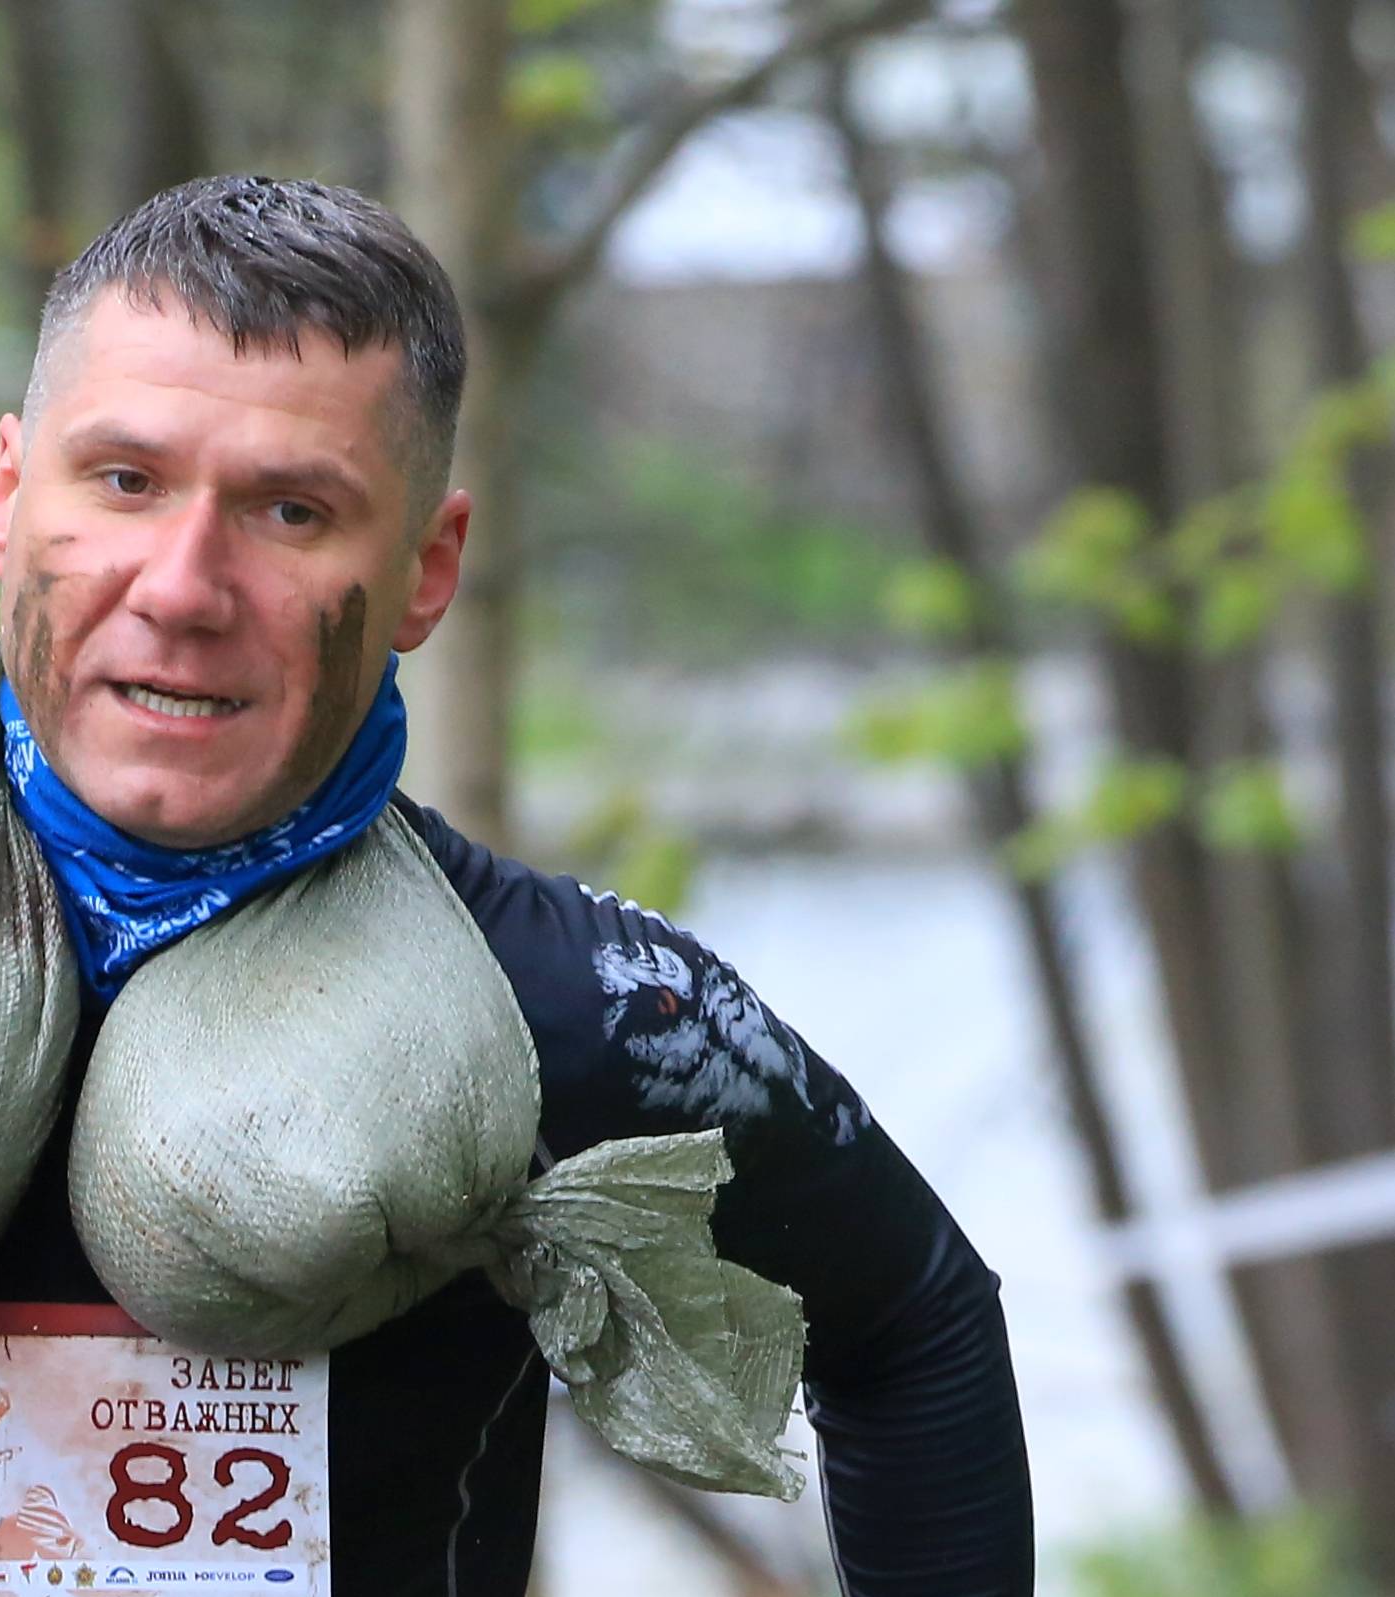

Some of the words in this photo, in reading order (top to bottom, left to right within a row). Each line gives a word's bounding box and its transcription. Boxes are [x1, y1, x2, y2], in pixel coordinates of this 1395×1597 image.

[170, 1356, 304, 1391] ЗАБЕГ
[91, 1397, 300, 1435] ОТВАЖНЫХ
[106, 1441, 293, 1550] 82
